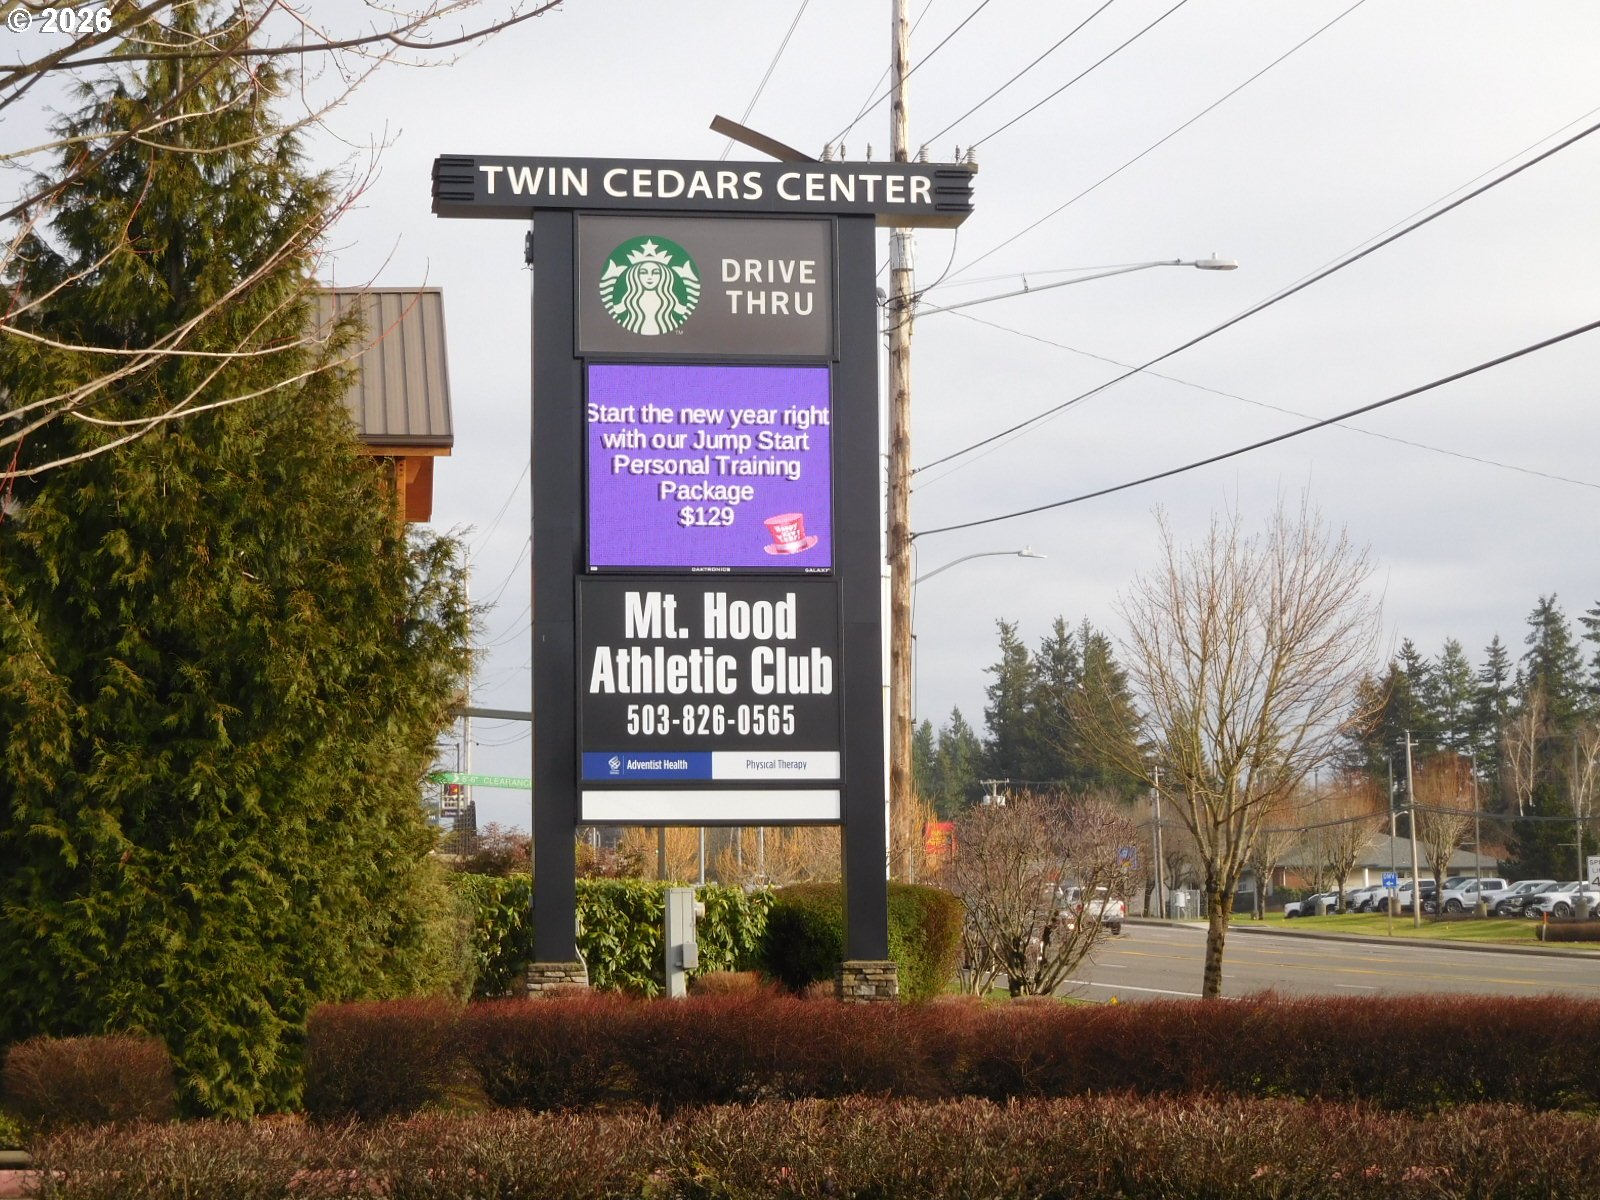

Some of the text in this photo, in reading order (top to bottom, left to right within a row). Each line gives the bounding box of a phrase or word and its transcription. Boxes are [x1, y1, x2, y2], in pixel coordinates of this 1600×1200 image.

[479, 165, 932, 204] TWIN CEDARS CENTER
[721, 258, 817, 285] DRIVE
[725, 289, 813, 316] THRU
[587, 402, 830, 430] Start the new year right
[603, 428, 810, 453] with our Jump Start
[614, 454, 801, 481] Personal Training
[661, 480, 755, 506] Package
[680, 505, 735, 527] $129
[625, 591, 797, 640] Mt. Hood
[589, 646, 833, 695] Athletic Club
[627, 704, 795, 736] 503-826-0565
[626, 759, 688, 770] Adventist Health
[746, 759, 808, 771] Physical Therapy
[483, 776, 532, 787] CLEARANC
